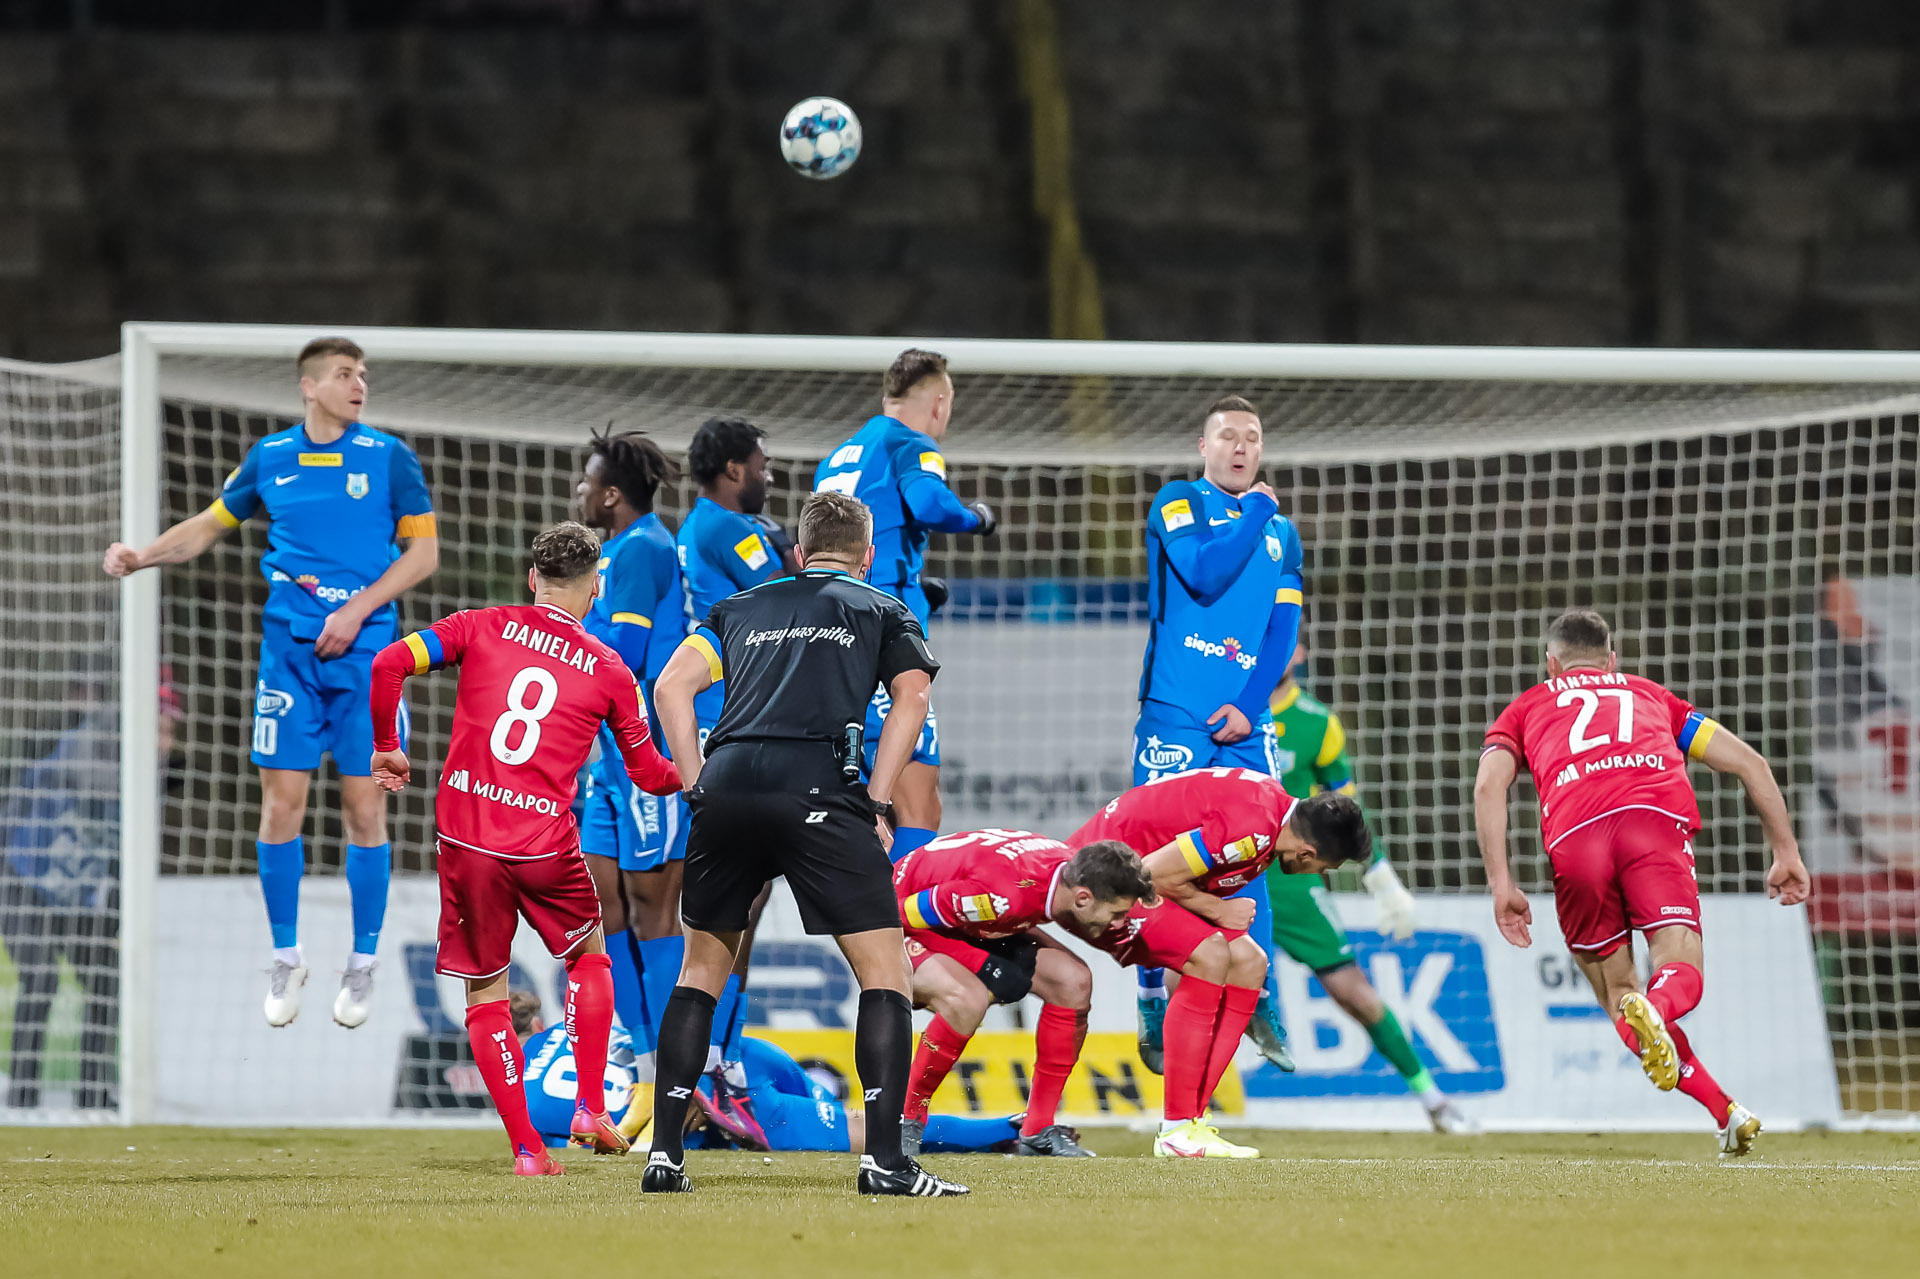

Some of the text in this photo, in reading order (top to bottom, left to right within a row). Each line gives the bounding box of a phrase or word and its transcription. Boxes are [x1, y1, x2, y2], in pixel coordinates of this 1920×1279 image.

[501, 620, 599, 676] DANIELAK
[786, 626, 816, 641] nas
[809, 626, 856, 648] piłka
[489, 665, 559, 766] 8
[1556, 688, 1634, 755] 27
[1149, 749, 1183, 764] LOTTO
[1585, 754, 1666, 775] MURAPOL
[472, 780, 560, 817] MURAPOL
[492, 1029, 519, 1086] WIDZEW
